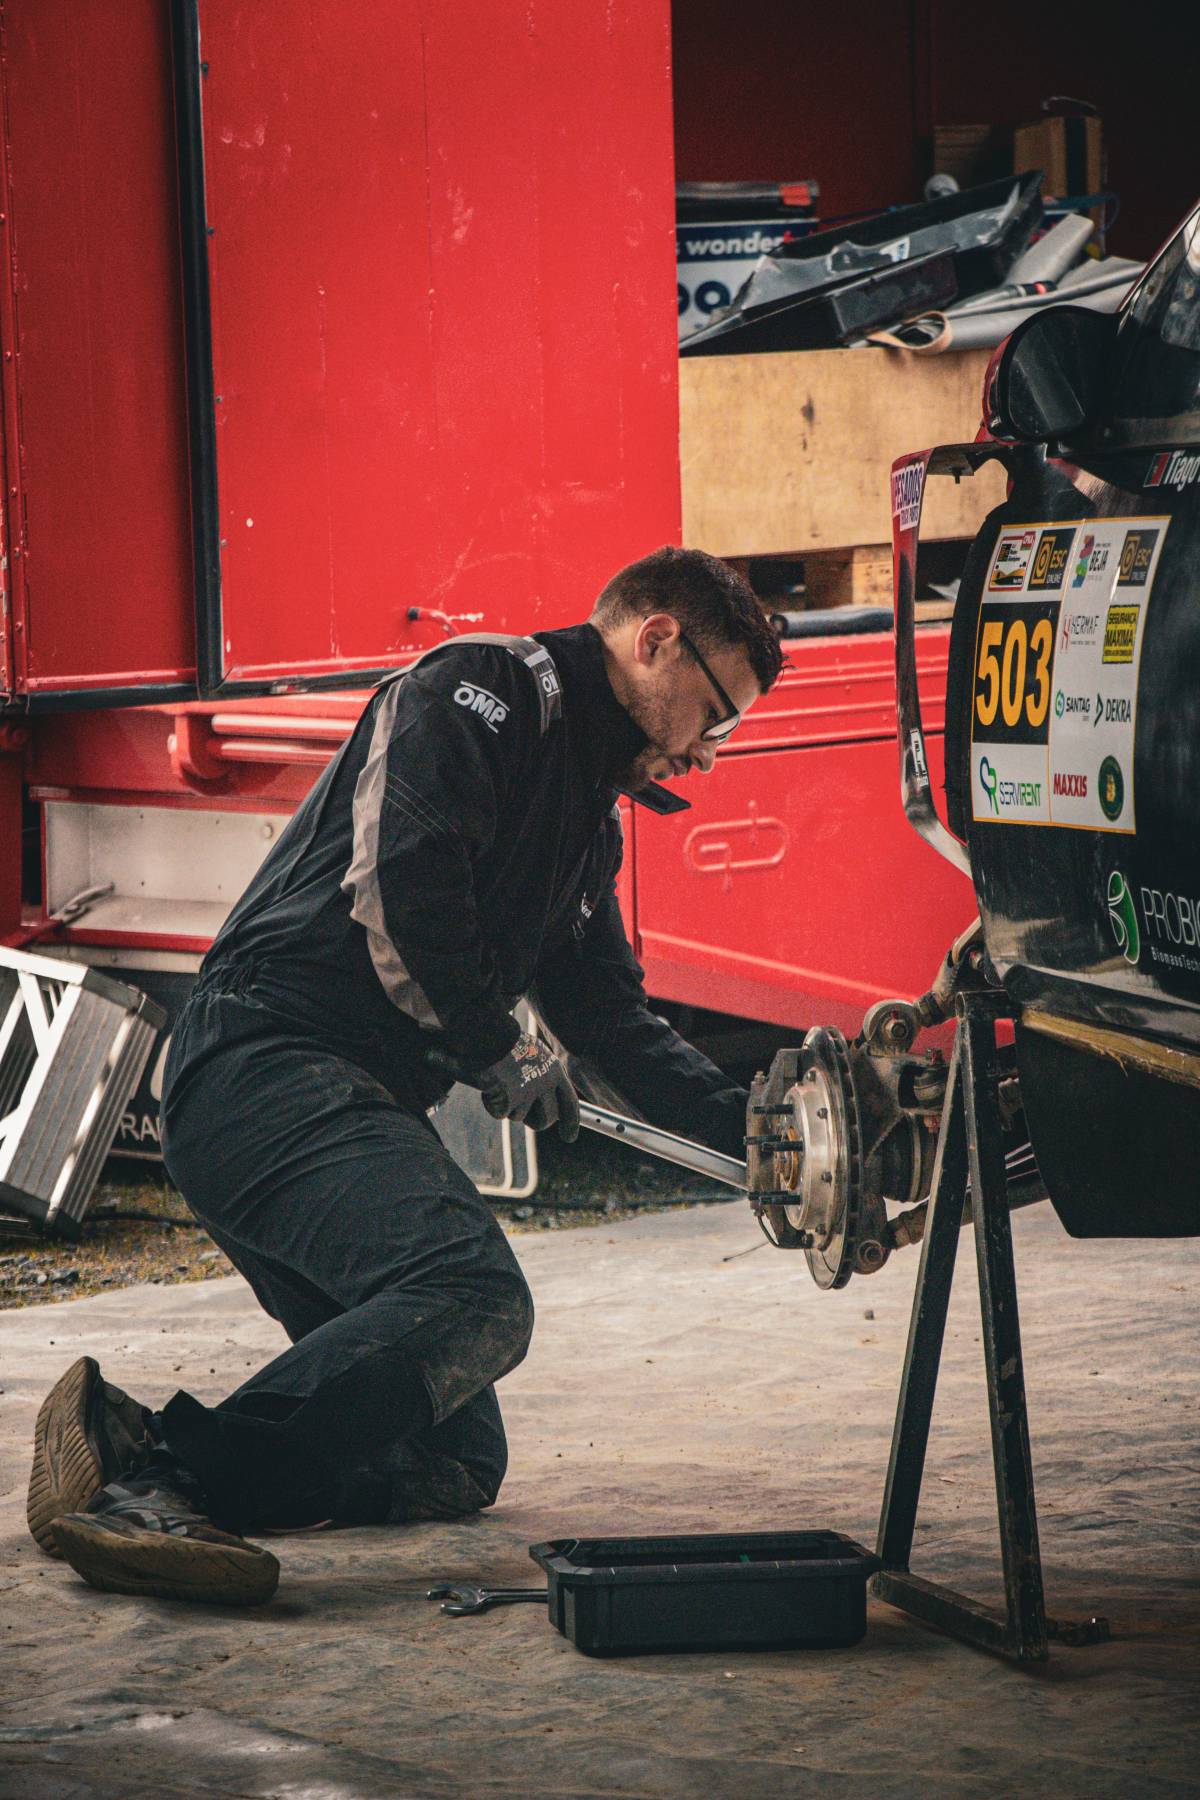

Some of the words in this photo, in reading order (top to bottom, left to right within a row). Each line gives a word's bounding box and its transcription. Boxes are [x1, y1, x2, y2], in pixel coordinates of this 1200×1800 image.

[1088, 550, 1109, 572] BEJA
[976, 619, 1053, 727] 503
[453, 686, 507, 724] OMP
[1065, 696, 1091, 713] SANTAG
[1105, 699, 1132, 722] DEKRA
[1000, 782, 1041, 806] SERVIRENT
[1053, 774, 1087, 797] MAXXIS
[120, 1112, 161, 1142] RA
